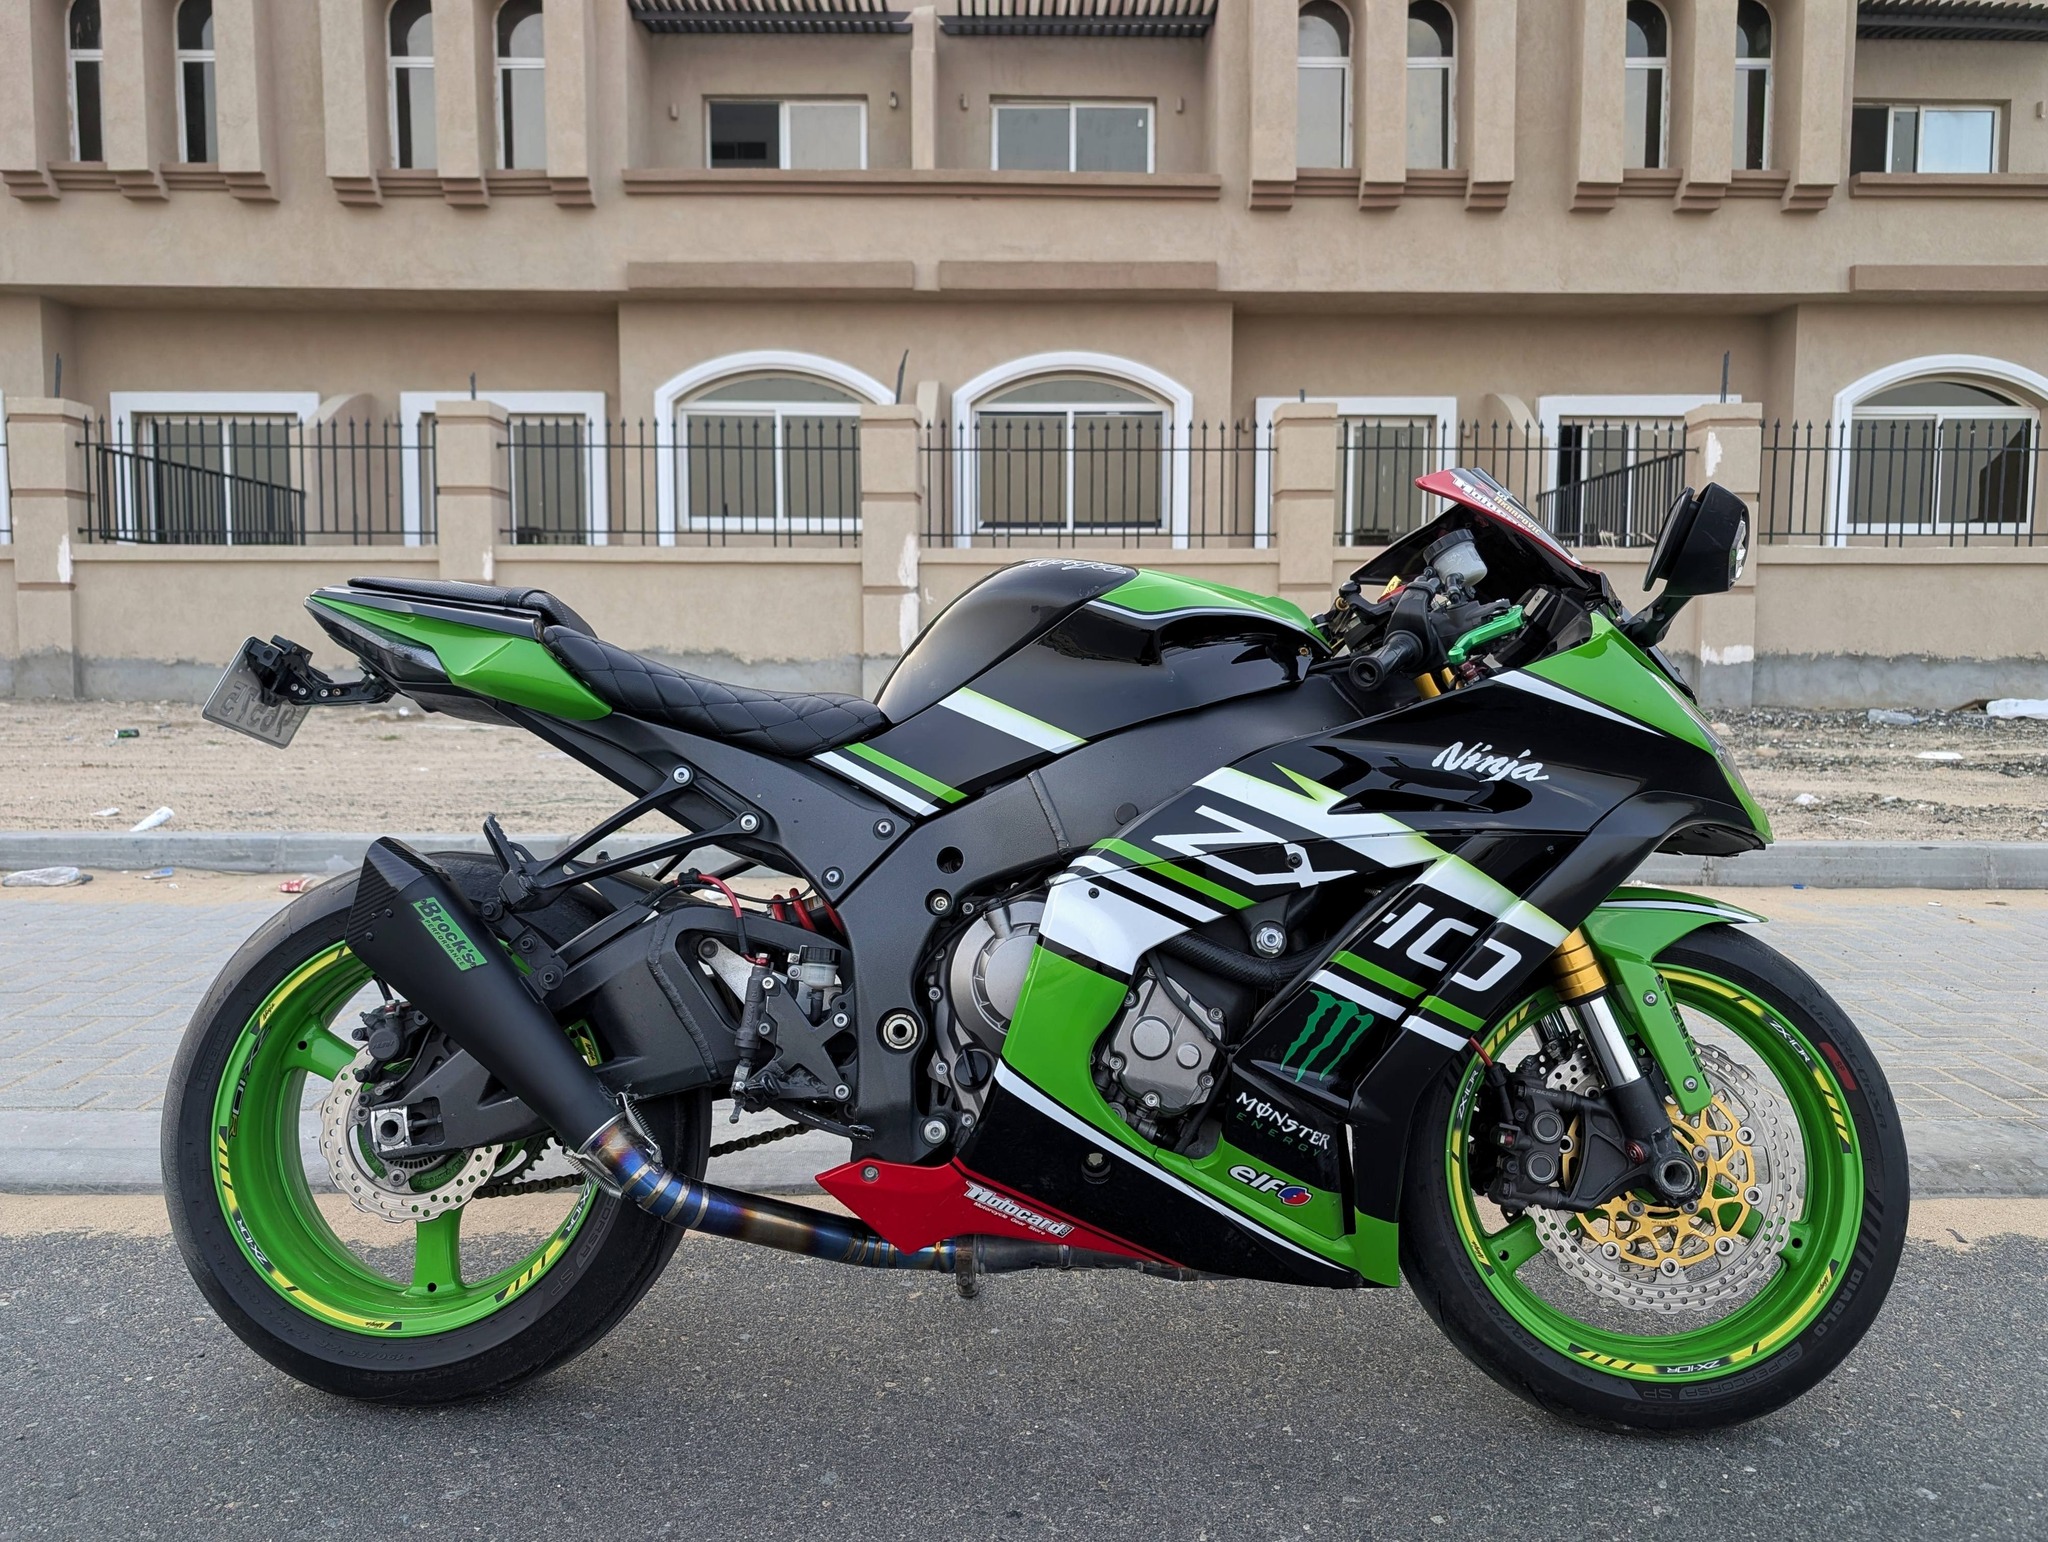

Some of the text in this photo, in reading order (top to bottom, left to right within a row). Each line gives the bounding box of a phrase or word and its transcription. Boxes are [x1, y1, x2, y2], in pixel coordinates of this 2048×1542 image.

[1432, 741, 1549, 782] Ninja
[418, 902, 476, 965] Brock's
[425, 920, 466, 967] PERFORMANCE
[262, 1002, 275, 1021] Ninja
[1769, 1020, 1811, 1063] ZX-10R
[1799, 991, 1888, 1129] SUPERCORSA
[1834, 1060, 1846, 1073] SP
[1456, 1070, 1479, 1121] ZX-10R
[1236, 1112, 1321, 1157] ENERGY
[1229, 1165, 1287, 1193] elf
[964, 1181, 1066, 1236] Motocard
[973, 1202, 1008, 1220] Motorcycle
[1010, 1217, 1026, 1227] Gear
[1028, 1225, 1046, 1236] Store
[237, 1218, 268, 1265] ZX-10R
[1643, 1268, 1864, 1400] DIABLO SUPERCORSA SP
[1667, 1359, 1720, 1373] ZX-10R
